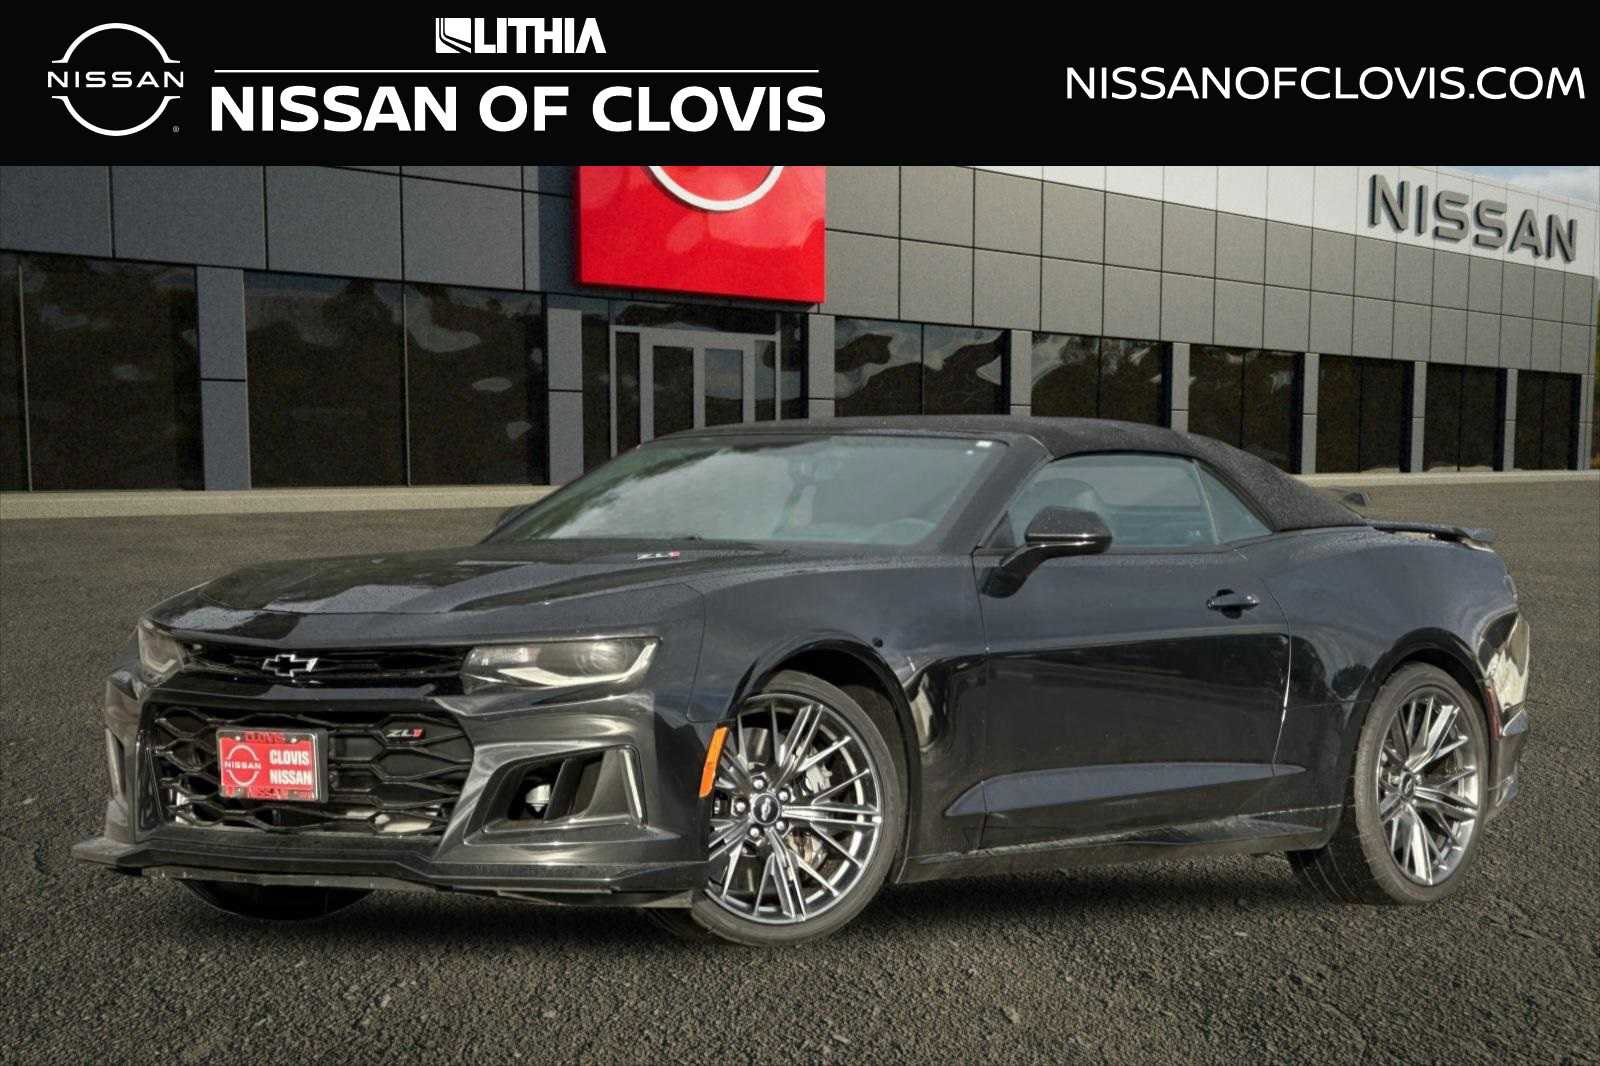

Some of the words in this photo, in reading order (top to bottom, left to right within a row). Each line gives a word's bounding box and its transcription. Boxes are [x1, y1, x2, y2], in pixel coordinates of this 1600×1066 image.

[1368, 174, 1578, 262] NISSAN
[269, 749, 310, 765] CLOVIS
[224, 760, 262, 770] NISSAN
[269, 770, 313, 785] NISSAN
